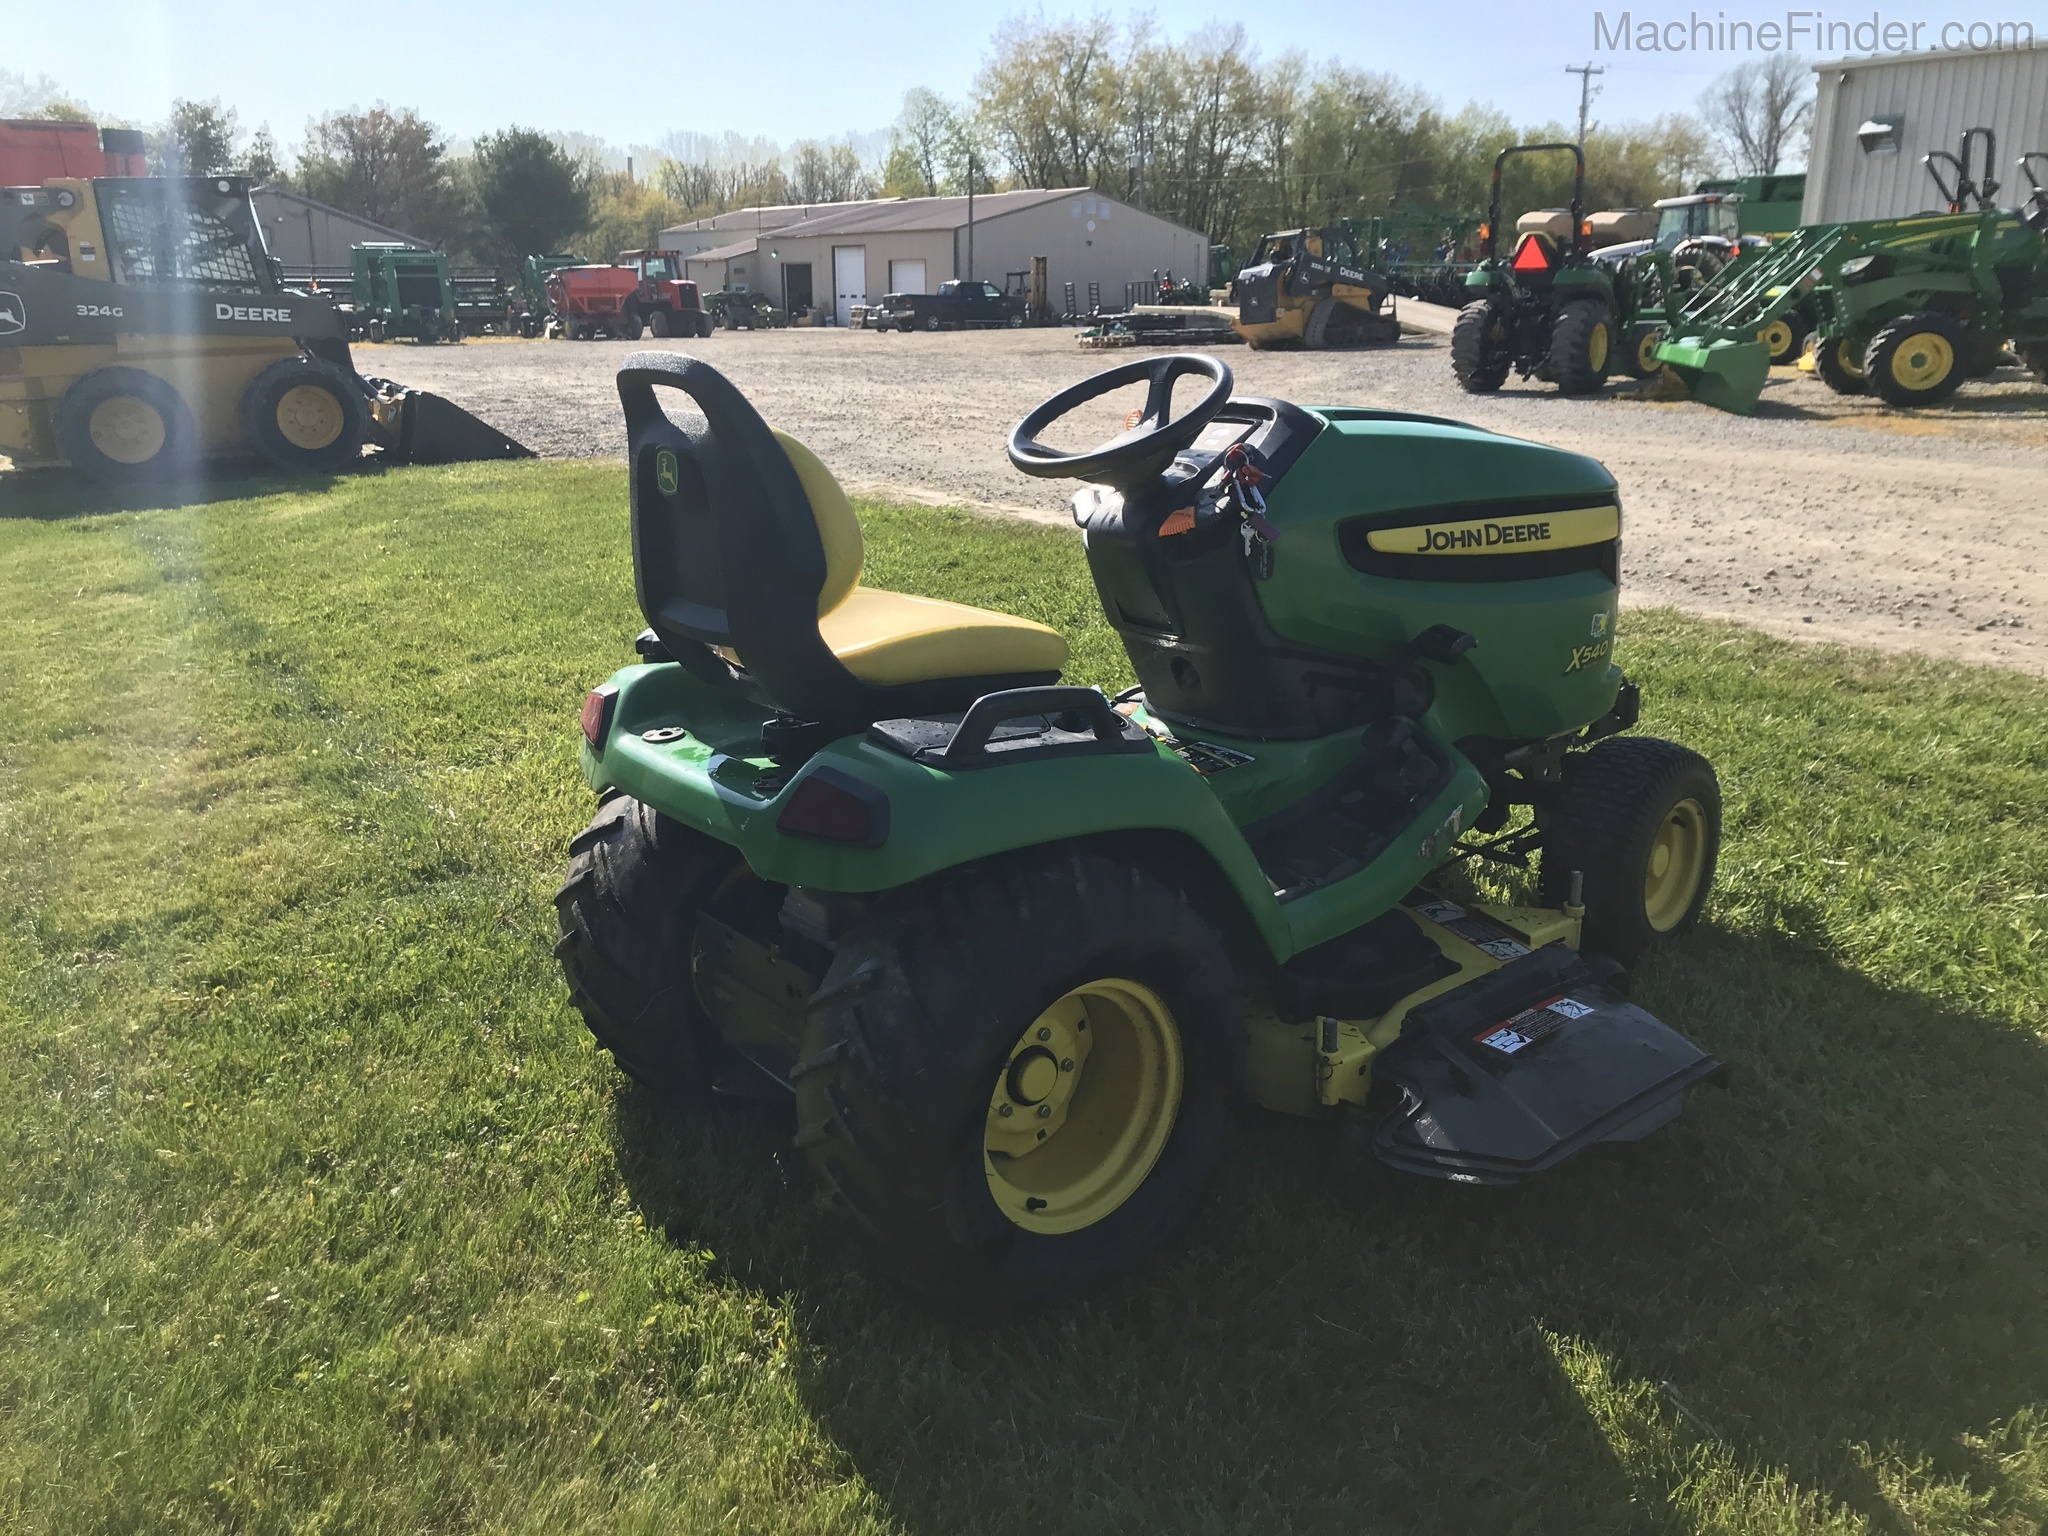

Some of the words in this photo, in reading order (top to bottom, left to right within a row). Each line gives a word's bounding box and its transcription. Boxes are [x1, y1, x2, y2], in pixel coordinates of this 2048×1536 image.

[1339, 266, 1364, 282] DEERE
[76, 304, 124, 318] 324G
[215, 303, 292, 323] DEERE
[1417, 528, 1482, 552] JOHN
[1484, 522, 1551, 546] DEERE
[1564, 640, 1609, 673] X540
